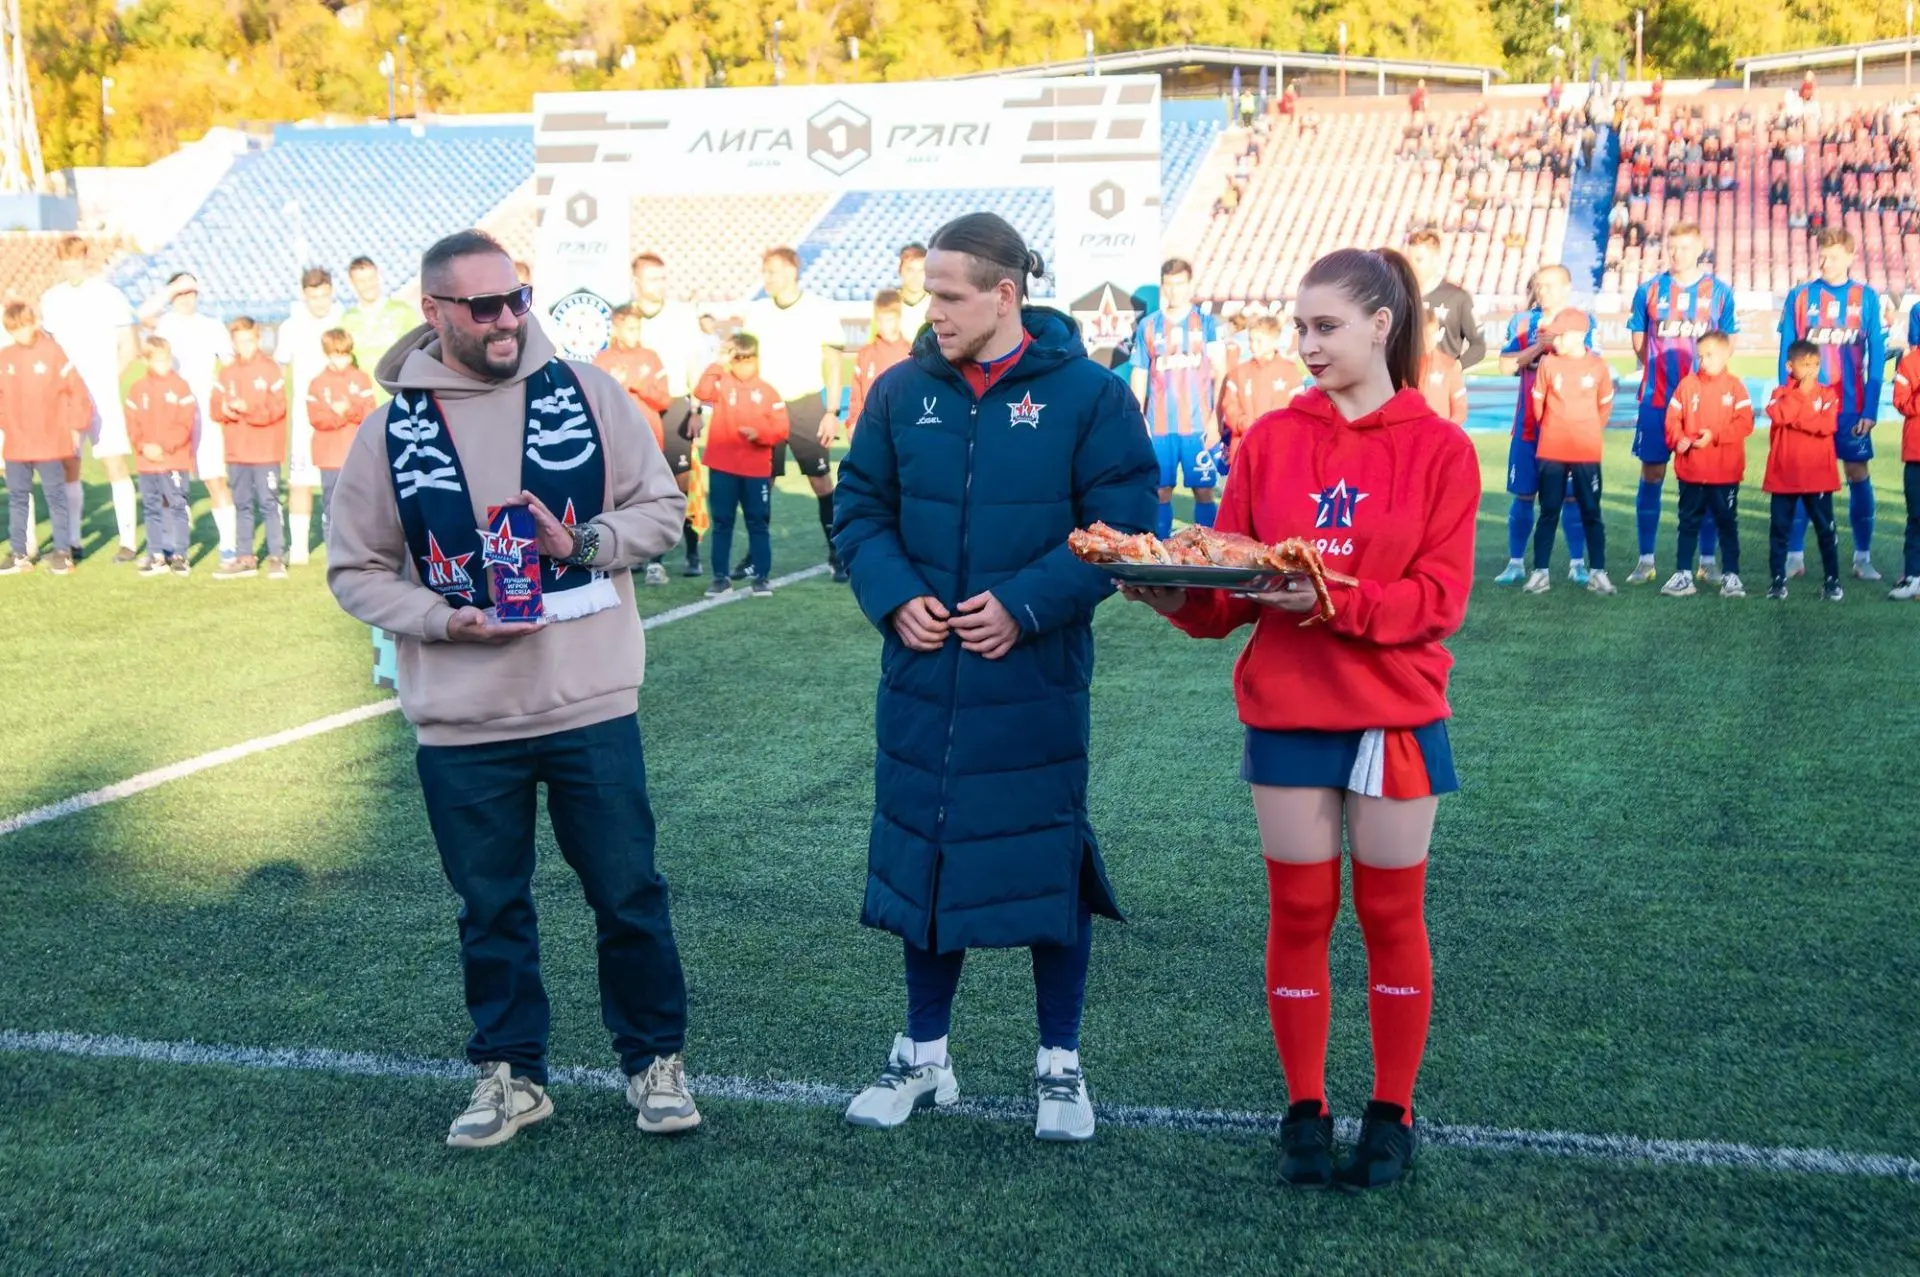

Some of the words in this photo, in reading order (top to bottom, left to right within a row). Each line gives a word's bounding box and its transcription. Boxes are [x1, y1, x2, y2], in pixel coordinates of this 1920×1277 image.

[684, 127, 794, 154] ЛИГА
[885, 121, 991, 149] PARI
[1079, 231, 1136, 248] PARI
[1657, 319, 1709, 338] LEON
[1805, 327, 1860, 345] LEON
[1313, 538, 1354, 556] 946
